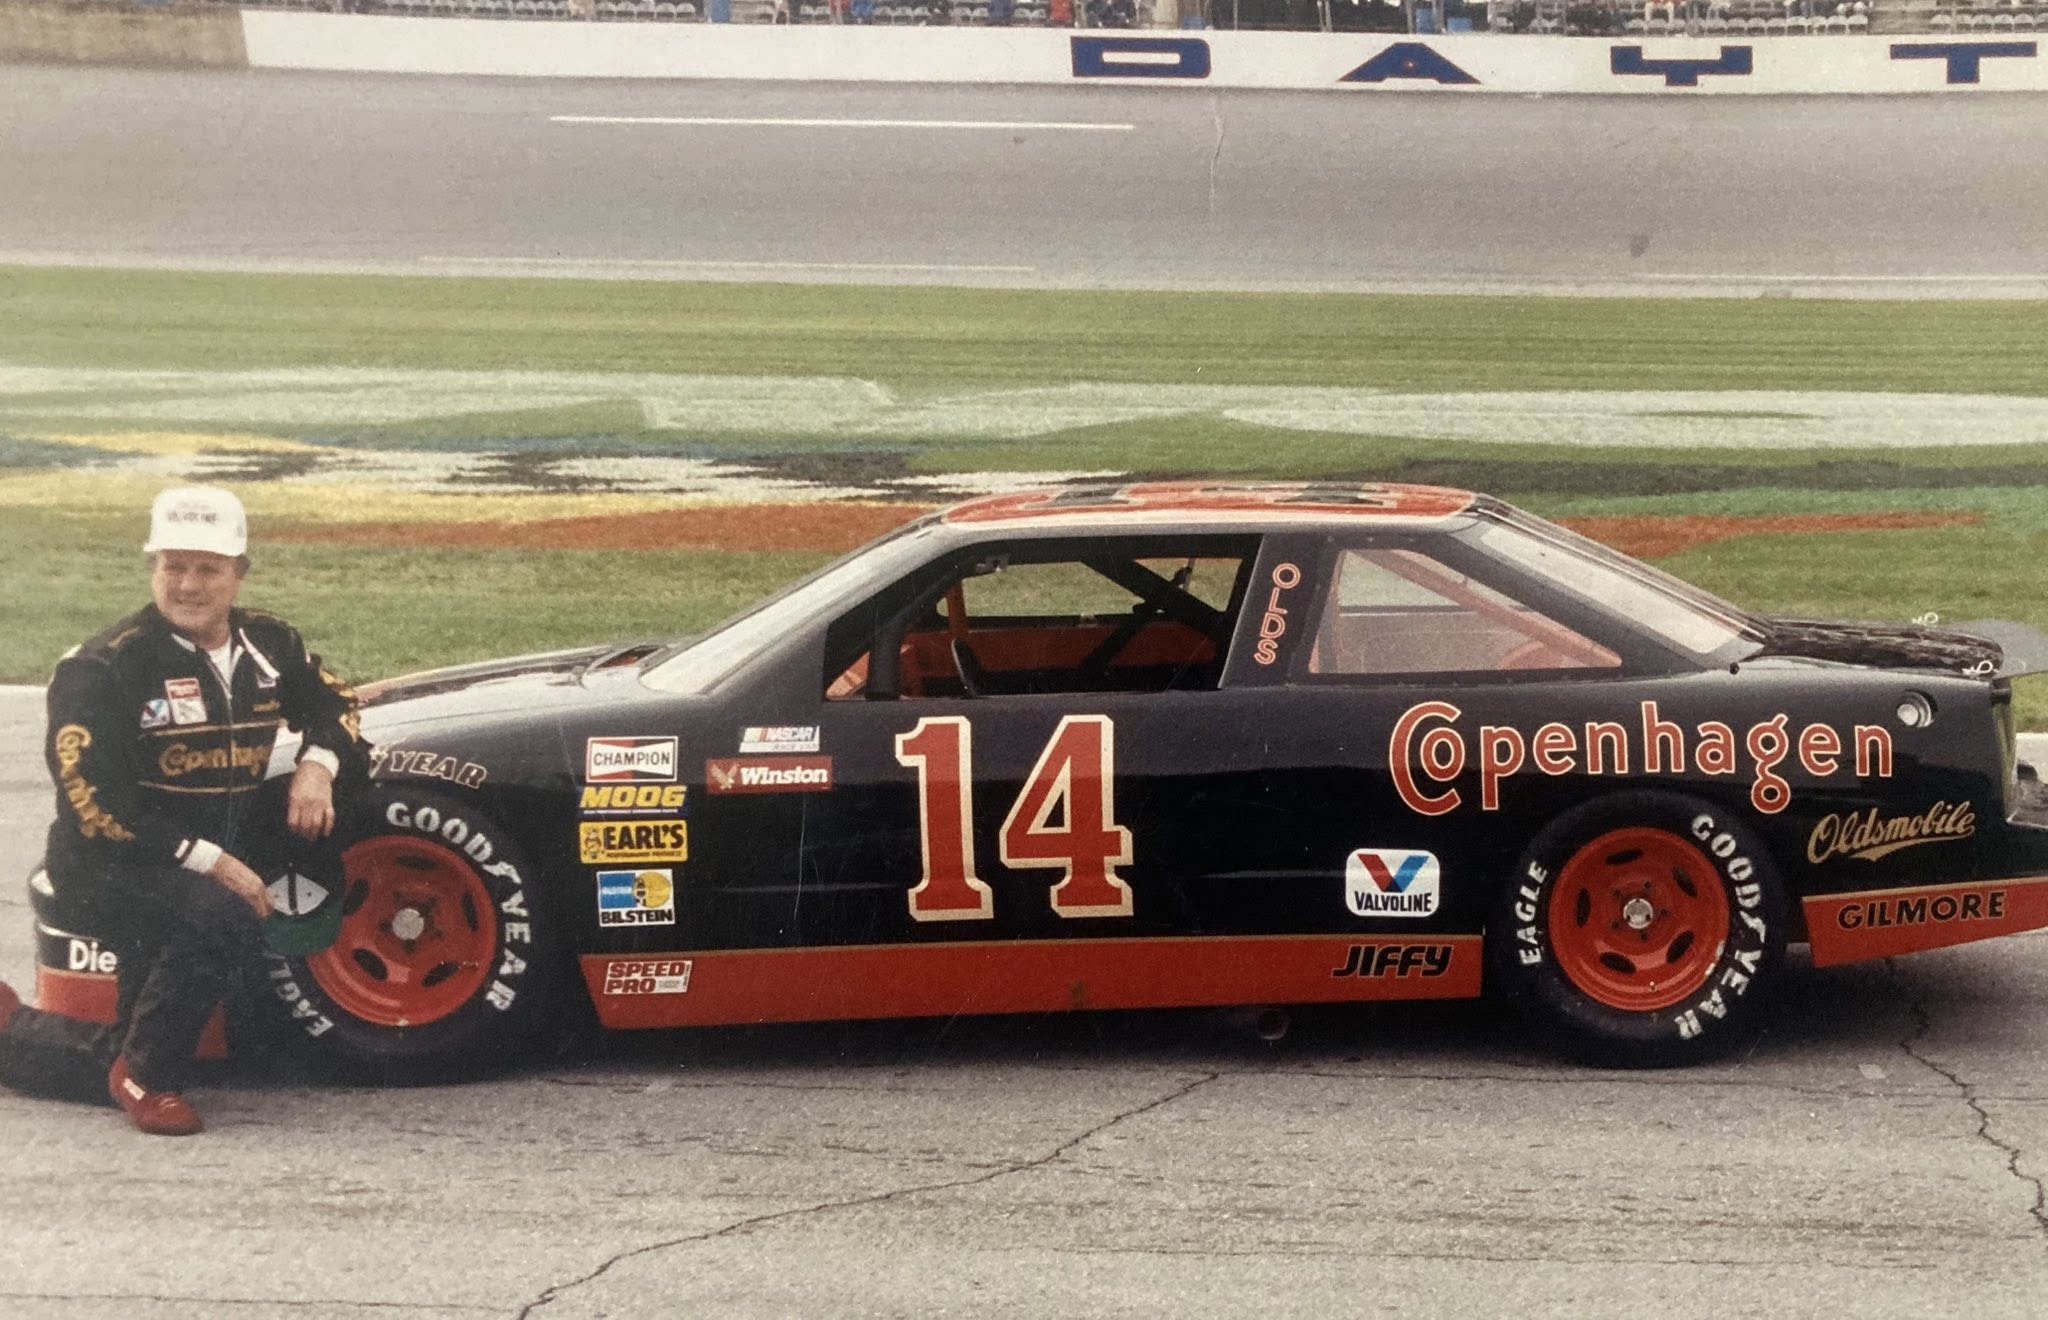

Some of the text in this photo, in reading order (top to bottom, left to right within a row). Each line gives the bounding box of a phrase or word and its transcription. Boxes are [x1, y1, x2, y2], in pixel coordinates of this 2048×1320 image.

[1255, 563, 1301, 665] OLDS
[767, 726, 814, 741] NASCAR
[593, 752, 671, 766] CHAMPION
[1389, 701, 1893, 816] Copenhagen
[740, 765, 828, 785] Winston
[580, 785, 687, 808] MOOG
[895, 714, 1134, 922] 14
[1807, 800, 1976, 864] Oldsmobile
[603, 824, 684, 850] EARL'S
[1354, 890, 1432, 912] VALVOLINE
[1515, 860, 1548, 965] EAGLE
[1837, 891, 2006, 931] GILMORE
[601, 909, 673, 924] BILSTEIN
[69, 939, 118, 972] Die
[608, 961, 686, 978] SPEED
[1330, 944, 1454, 978] JIFFY
[264, 953, 335, 1037] EAGL
[605, 978, 657, 993] PRO
